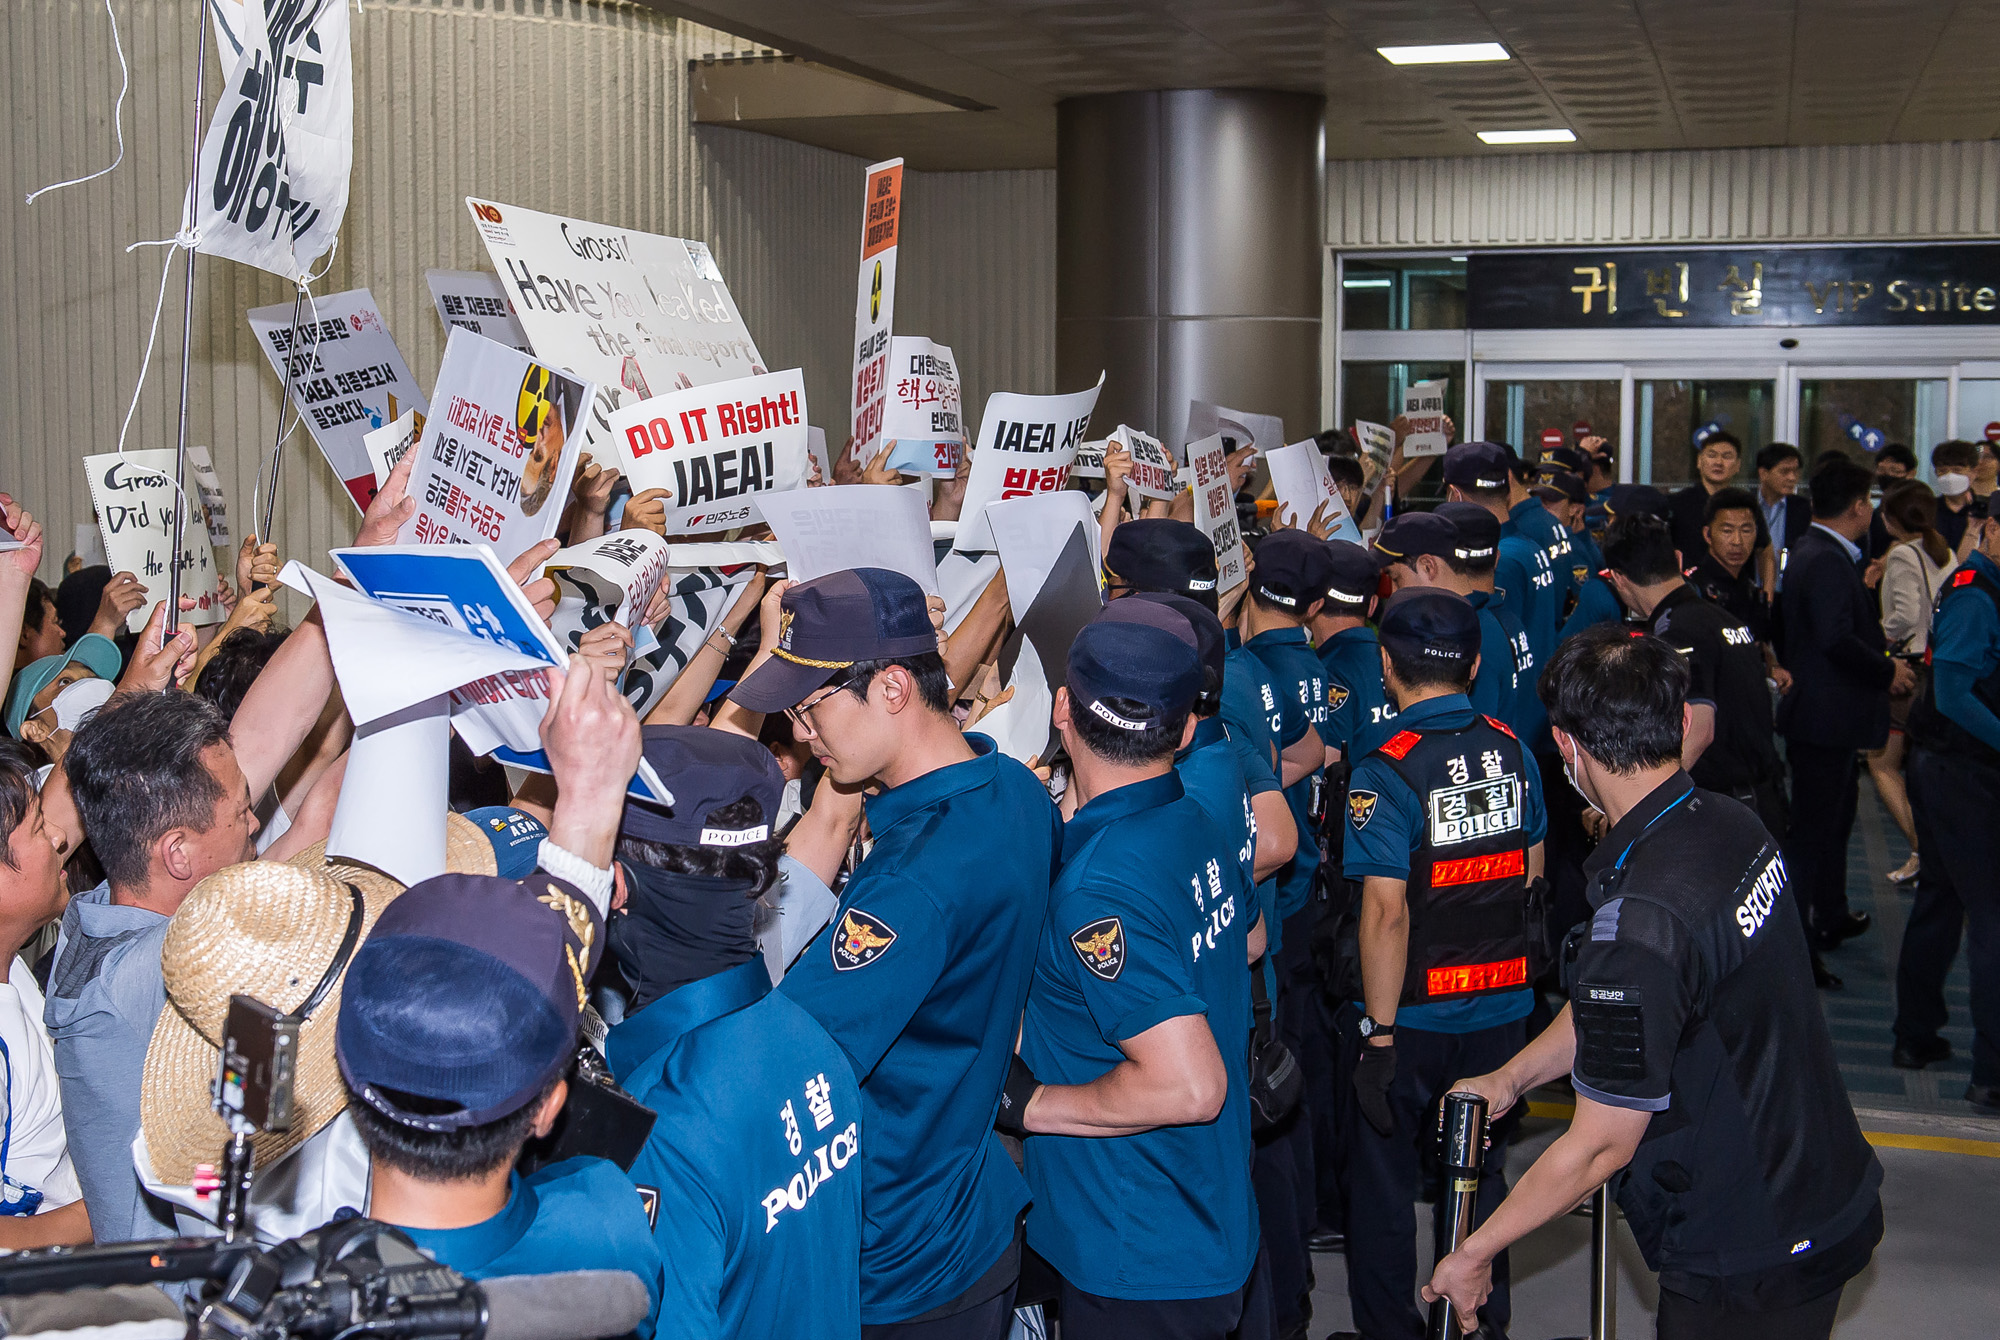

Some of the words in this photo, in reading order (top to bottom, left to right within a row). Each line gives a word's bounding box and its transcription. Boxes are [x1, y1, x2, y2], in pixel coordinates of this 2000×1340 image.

[472, 202, 503, 224] NO
[560, 223, 635, 266] Grossi!
[441, 294, 466, 315] 일본
[464, 296, 507, 318] 자료로만
[505, 258, 604, 320] Have
[598, 281, 646, 319] You
[642, 275, 733, 325] leaked
[1803, 279, 1875, 315] VIP
[587, 323, 637, 358] the
[684, 337, 758, 369] report
[335, 363, 398, 395] 최종보고서
[476, 409, 504, 447] 결사
[625, 416, 675, 460] DO
[679, 407, 709, 445] IT
[716, 390, 800, 438] Right!
[993, 419, 1057, 453] IAEA
[431, 431, 459, 469] 총재
[454, 444, 493, 487] 그로시
[104, 462, 169, 493] Grossi
[490, 463, 523, 505] IAEA
[673, 441, 774, 508] IAEA!
[1194, 454, 1210, 488] 일본
[425, 473, 471, 521] 뇌물받은
[106, 501, 150, 534] Did
[467, 500, 506, 543] 오염수
[705, 506, 751, 525] 민주노총
[143, 549, 164, 577] the
[1424, 647, 1462, 659] POLICE
[1095, 703, 1144, 731] POLICE
[1446, 748, 1504, 785] 경찰
[1442, 783, 1510, 821] 경찰
[708, 828, 762, 844] POLICE
[1446, 810, 1509, 838] POLICE
[837, 946, 861, 965] POLICE
[1097, 956, 1119, 971] POLICE
[1589, 989, 1625, 1001] 항공보안
[779, 1072, 836, 1157] 경찰
[760, 1121, 859, 1235] POLICE
